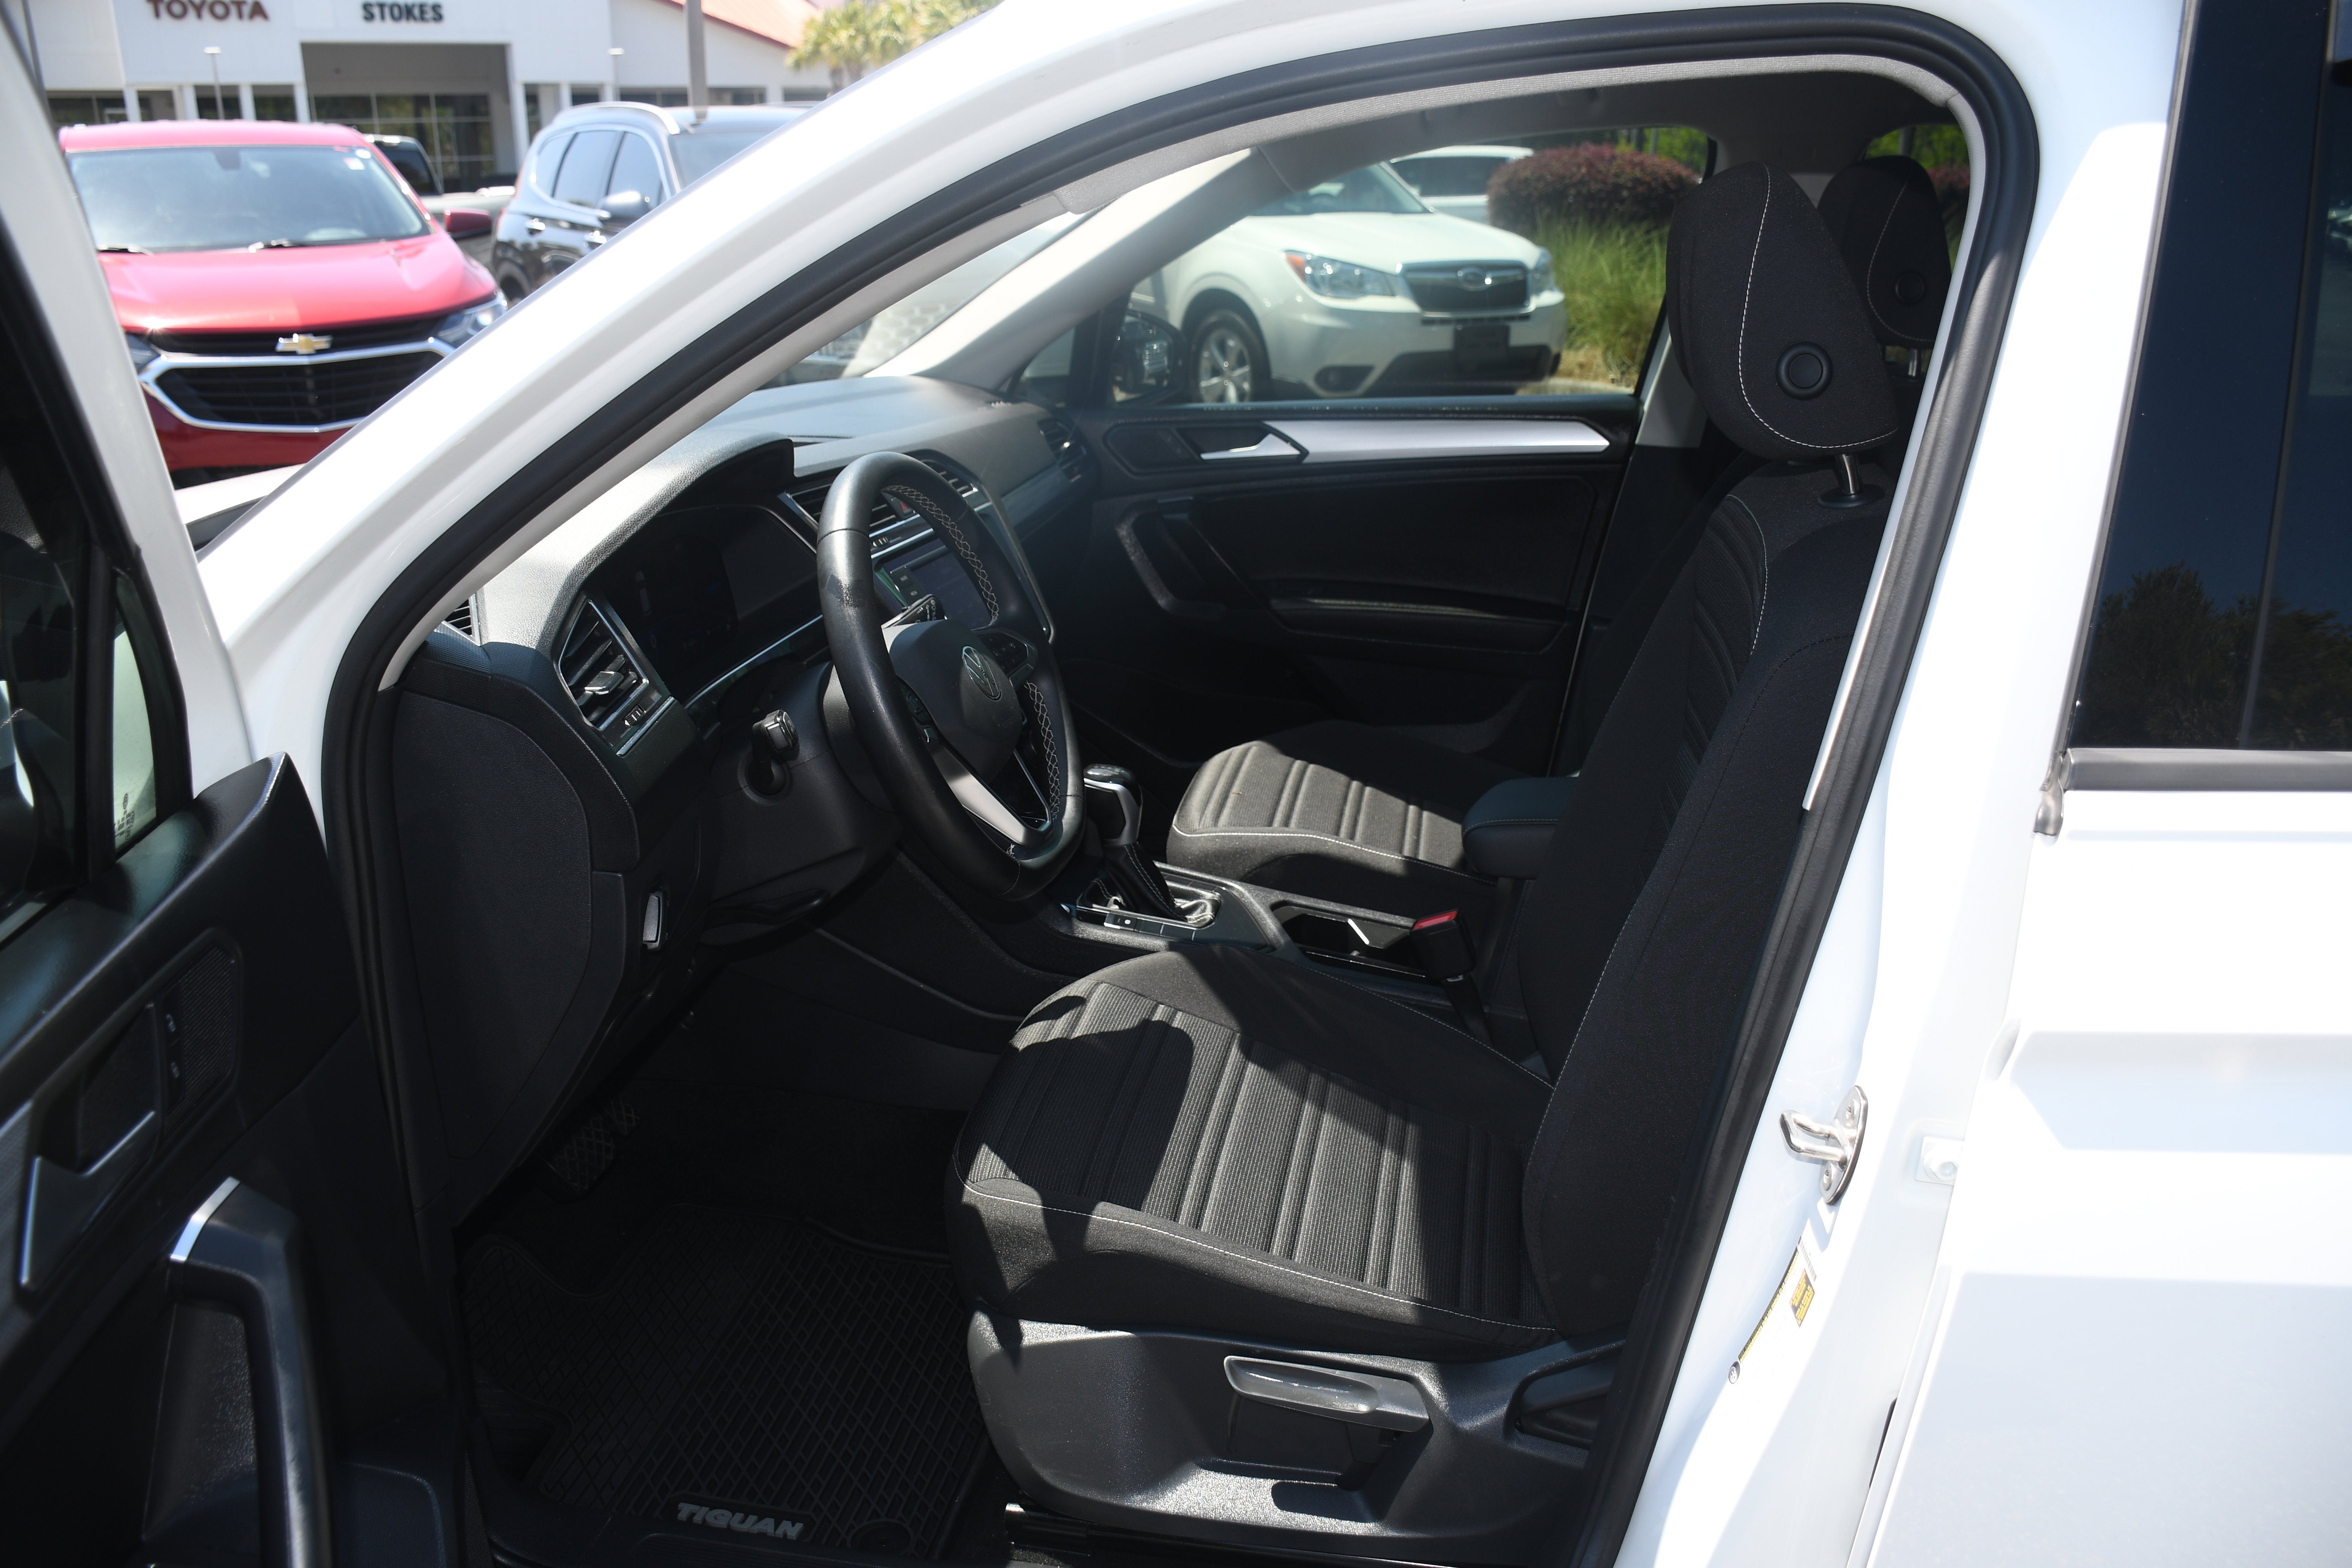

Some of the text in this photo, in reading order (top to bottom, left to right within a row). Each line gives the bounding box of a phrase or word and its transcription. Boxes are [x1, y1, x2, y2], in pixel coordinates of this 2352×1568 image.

[145, 0, 271, 20] TOYOTA
[362, 3, 443, 22] STOKES
[678, 1502, 803, 1540] TIGUAN
